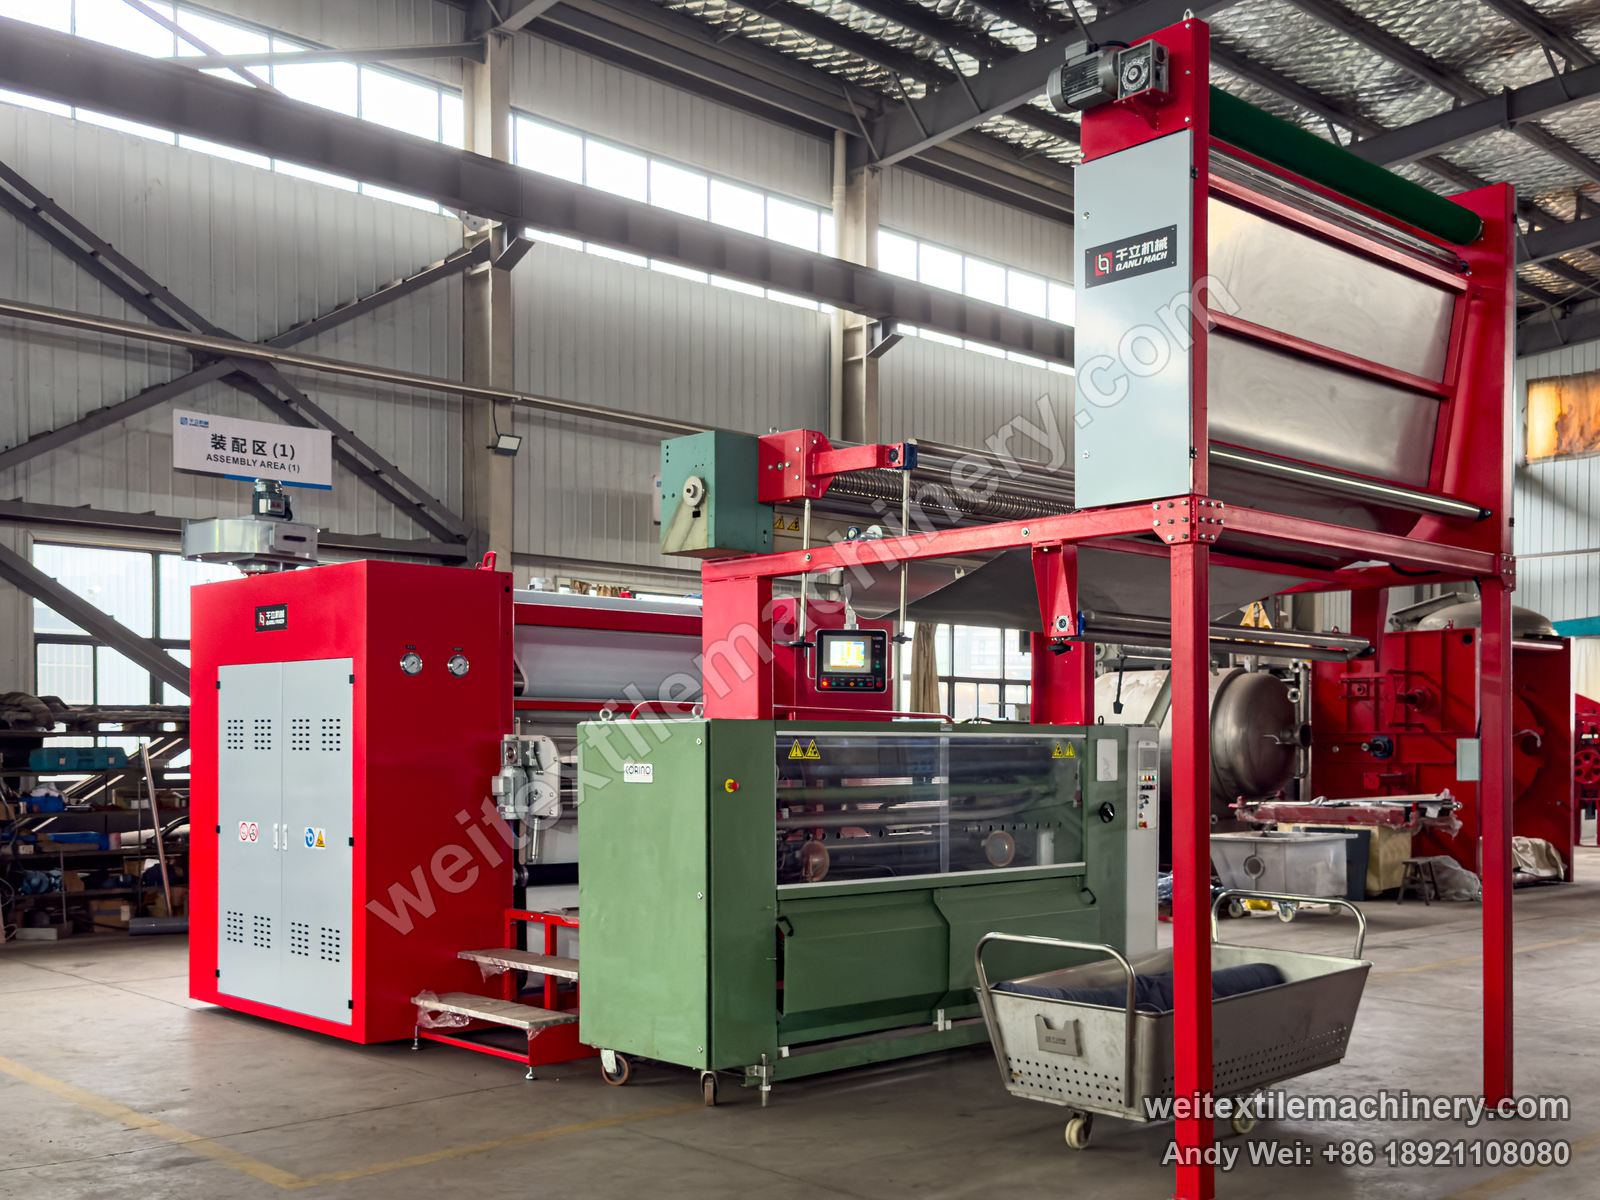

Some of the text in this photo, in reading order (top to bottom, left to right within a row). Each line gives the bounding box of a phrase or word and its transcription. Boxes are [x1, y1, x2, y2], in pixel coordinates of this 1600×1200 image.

[1115, 236, 1168, 261] 千立机械
[1142, 250, 1168, 265] MACH
[206, 453, 300, 473] ASSEMBLY AREA (1)
